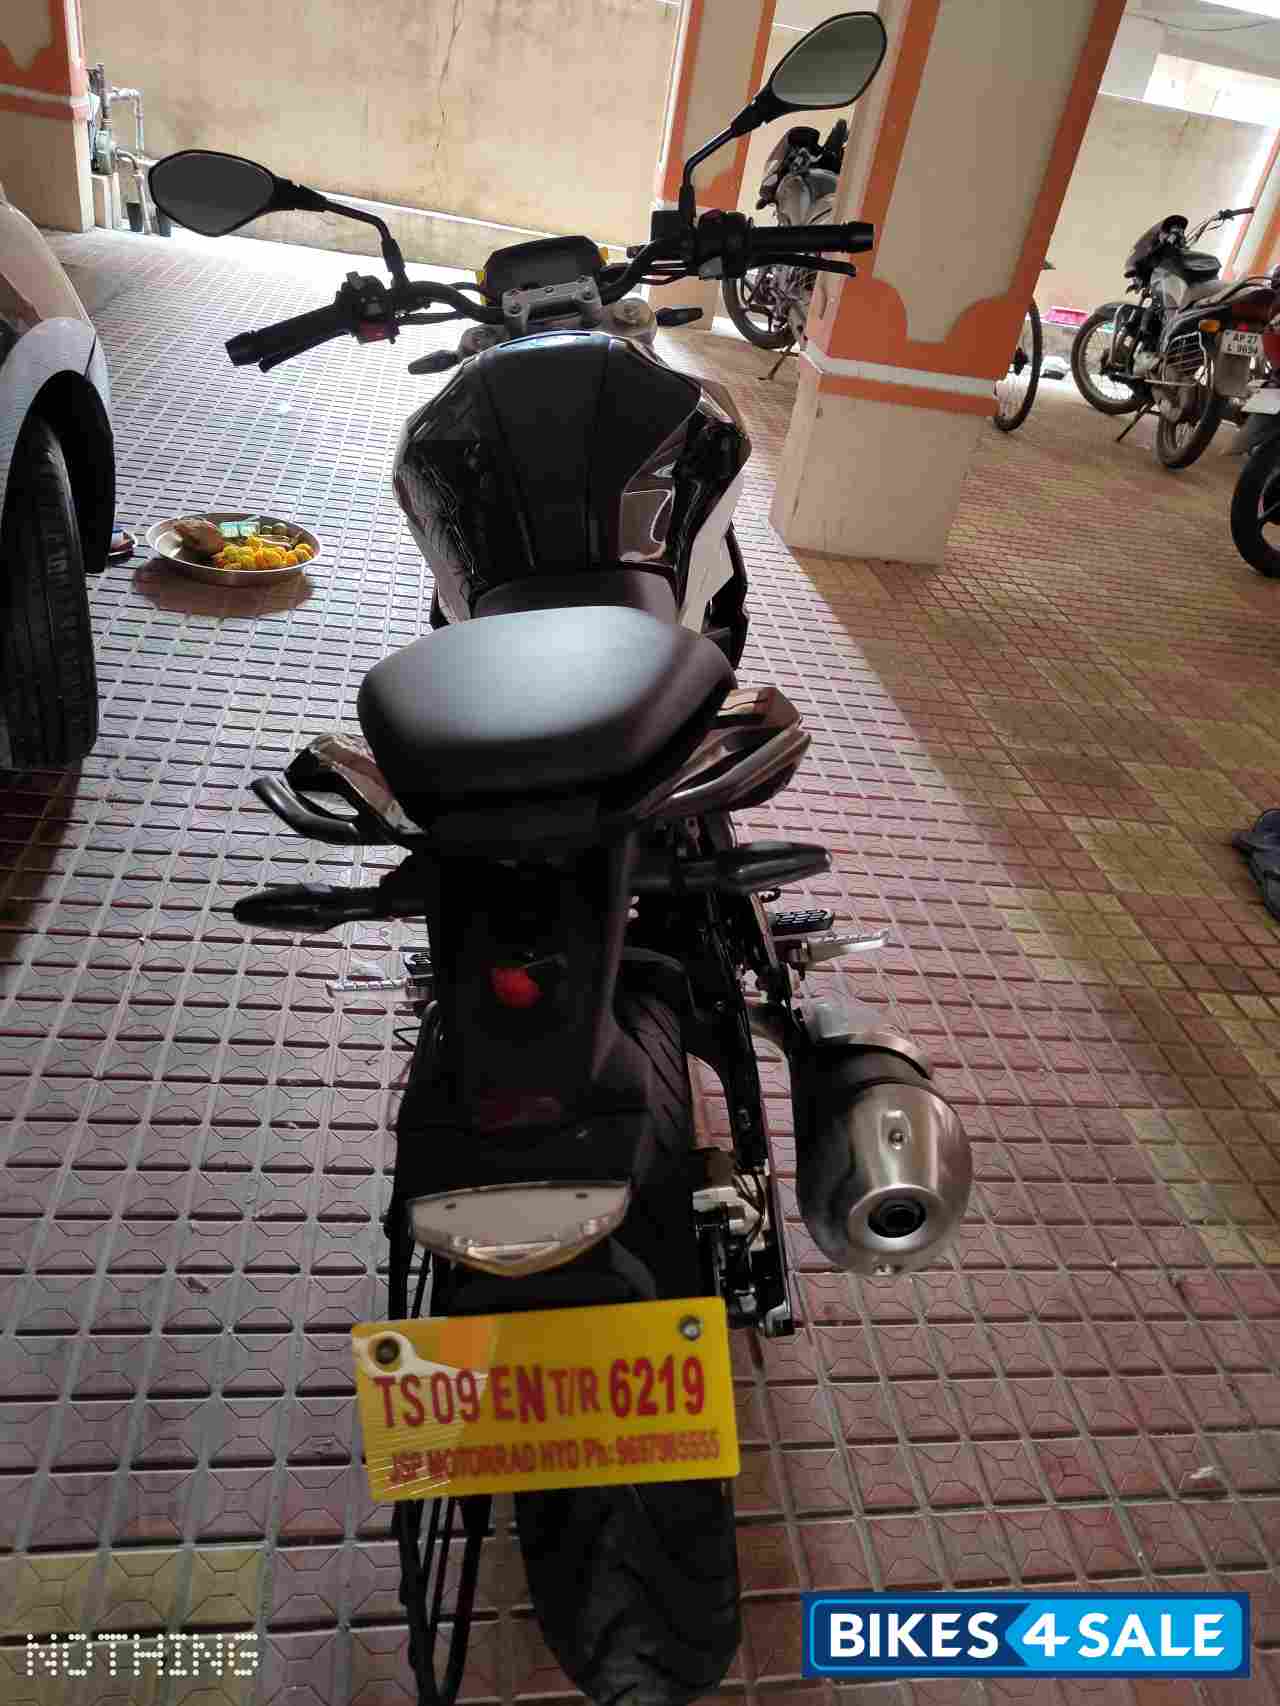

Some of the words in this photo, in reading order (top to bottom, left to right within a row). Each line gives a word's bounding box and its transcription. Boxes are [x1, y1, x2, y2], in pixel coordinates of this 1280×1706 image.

[1232, 332, 1246, 342] AP
[609, 1353, 705, 1418] 6219
[427, 1442, 537, 1480] MOTORRAD
